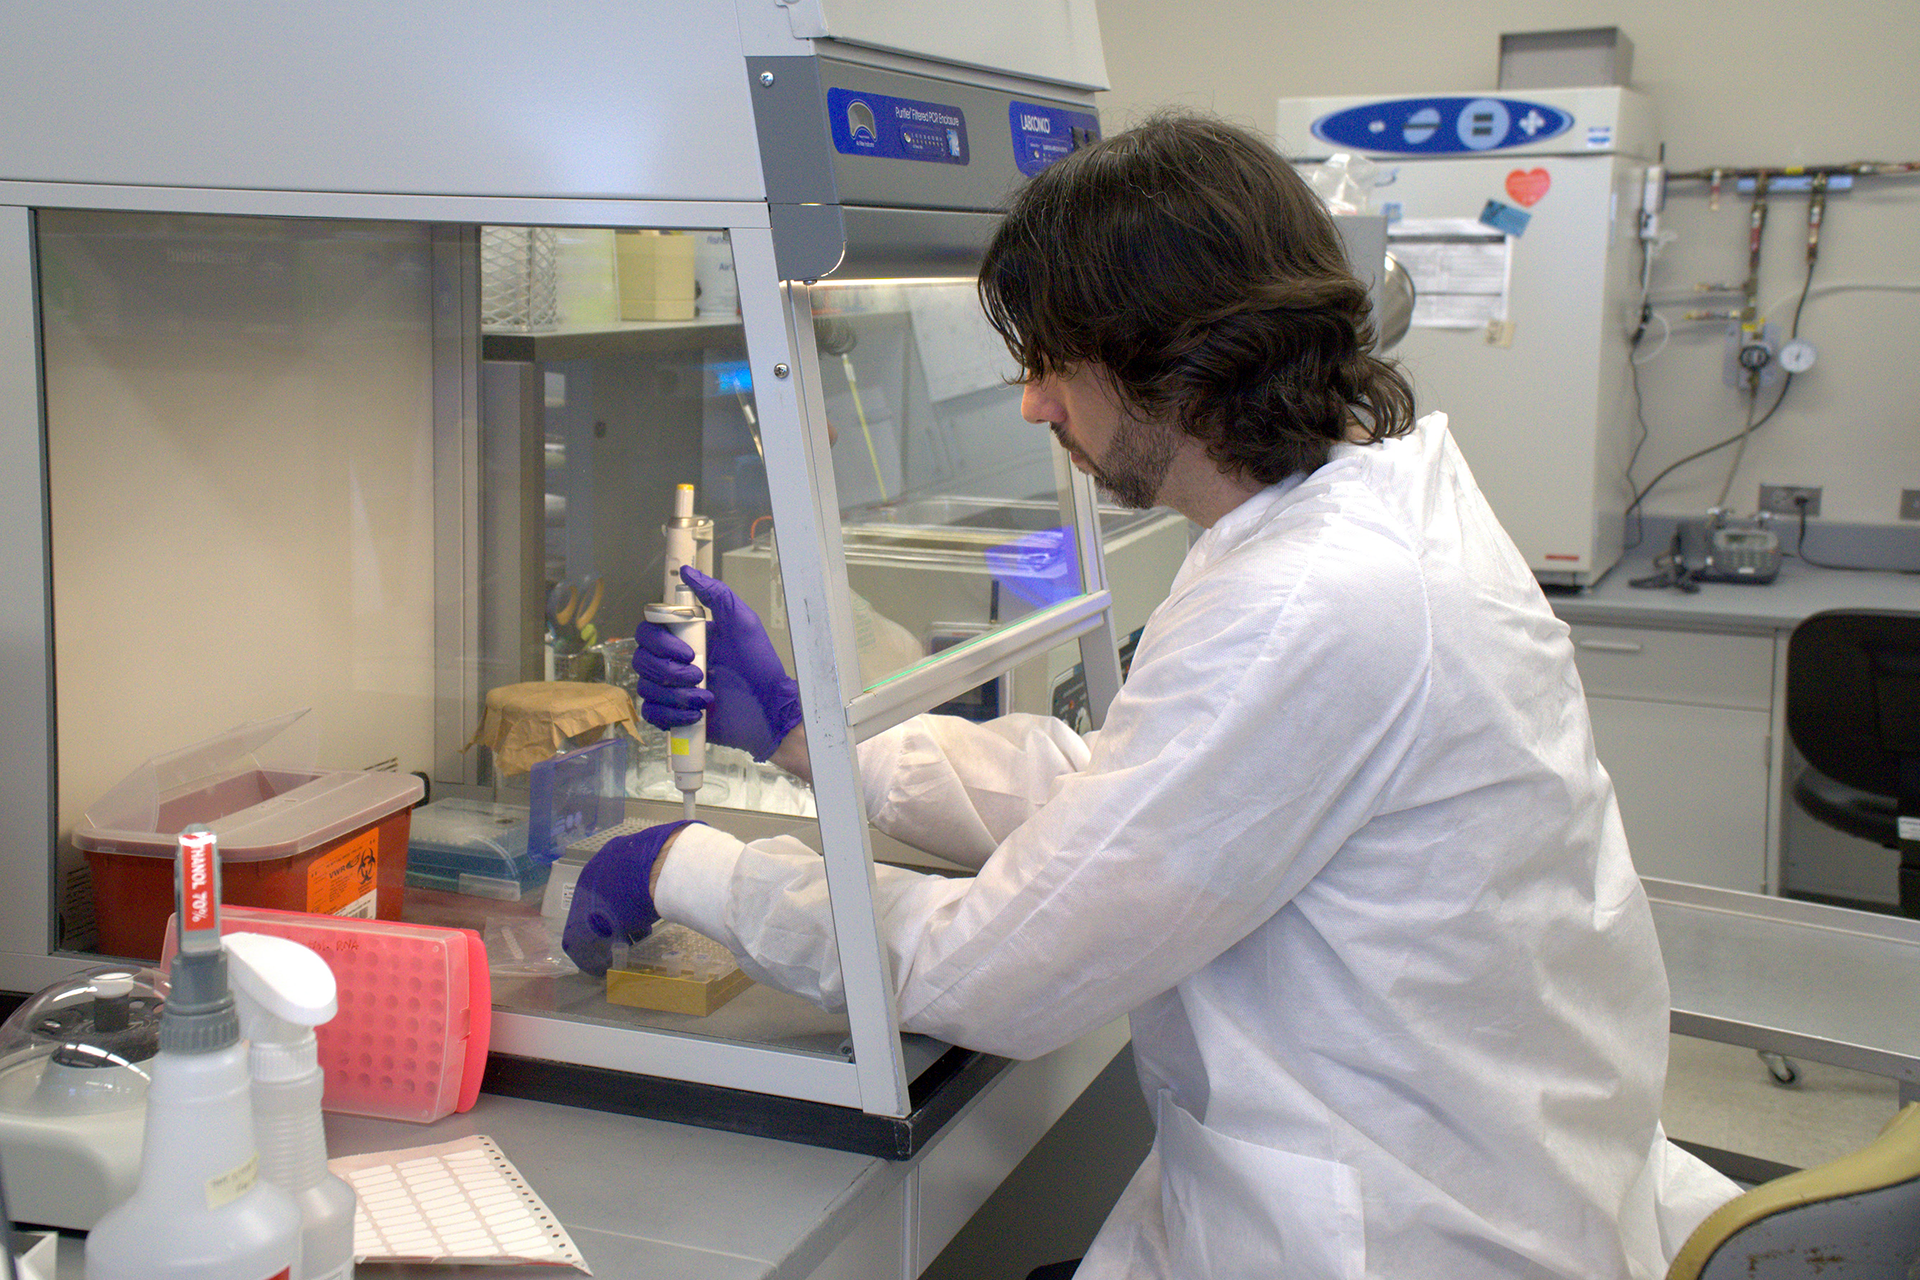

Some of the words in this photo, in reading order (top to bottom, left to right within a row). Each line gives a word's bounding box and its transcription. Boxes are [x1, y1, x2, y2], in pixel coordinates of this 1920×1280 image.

[911, 108, 929, 122] Filtered
[929, 111, 939, 124] PCR
[939, 113, 960, 126] Enclosure
[1020, 112, 1051, 134] LABCONCO
[190, 841, 207, 890] THANOL
[328, 864, 346, 879] VWR
[191, 890, 209, 923] 70%
[336, 939, 360, 952] RNA
